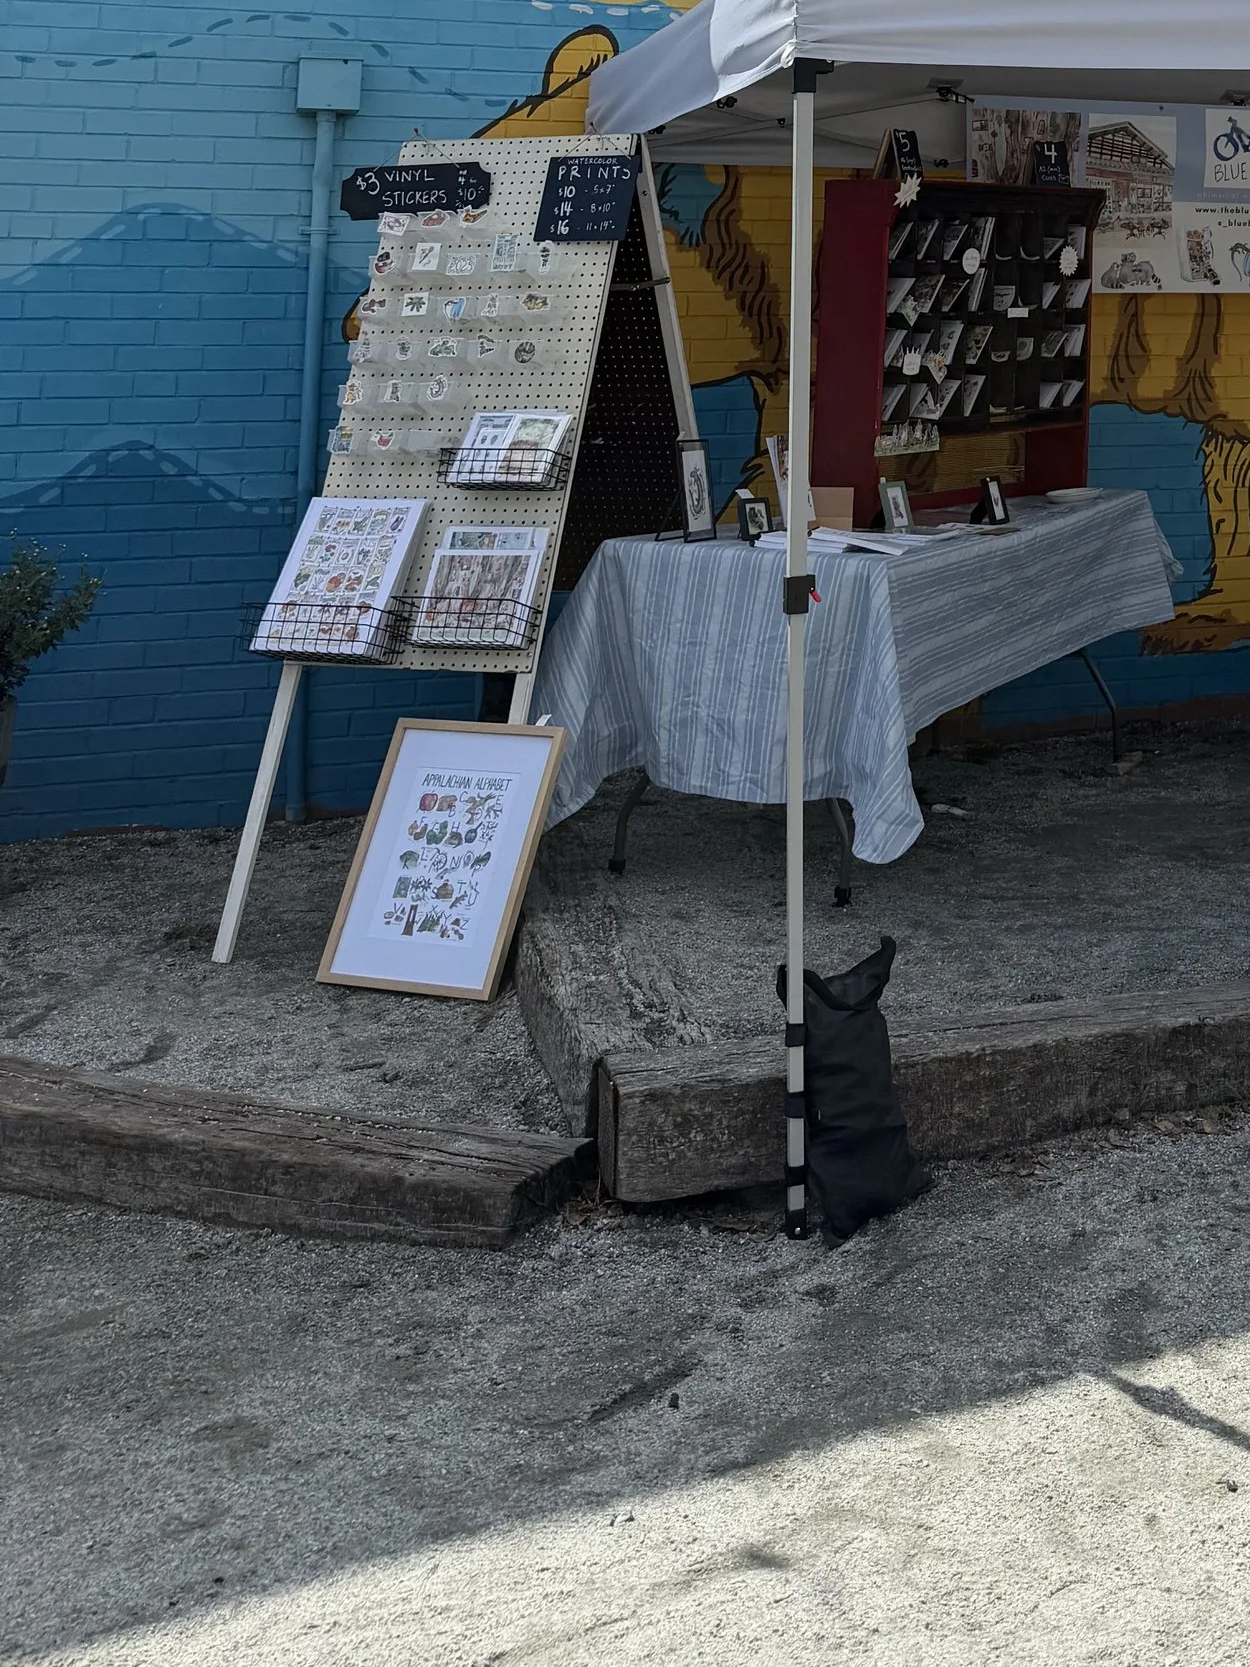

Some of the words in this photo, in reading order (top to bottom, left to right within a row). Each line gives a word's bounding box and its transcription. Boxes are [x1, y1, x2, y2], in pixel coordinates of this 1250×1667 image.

[567, 157, 618, 165] WATERCOLOR
[384, 169, 435, 183] VINYL
[557, 165, 631, 181] PRINTS
[1214, 162, 1248, 183] BLUE
[355, 171, 381, 195] $3
[382, 189, 447, 207] STICKERS
[458, 188, 477, 201] $10
[558, 185, 576, 198] $10
[553, 200, 574, 217] $14
[550, 219, 570, 235] $16
[421, 773, 473, 790] APPALACHIAN
[473, 776, 513, 792] ALPHABET
